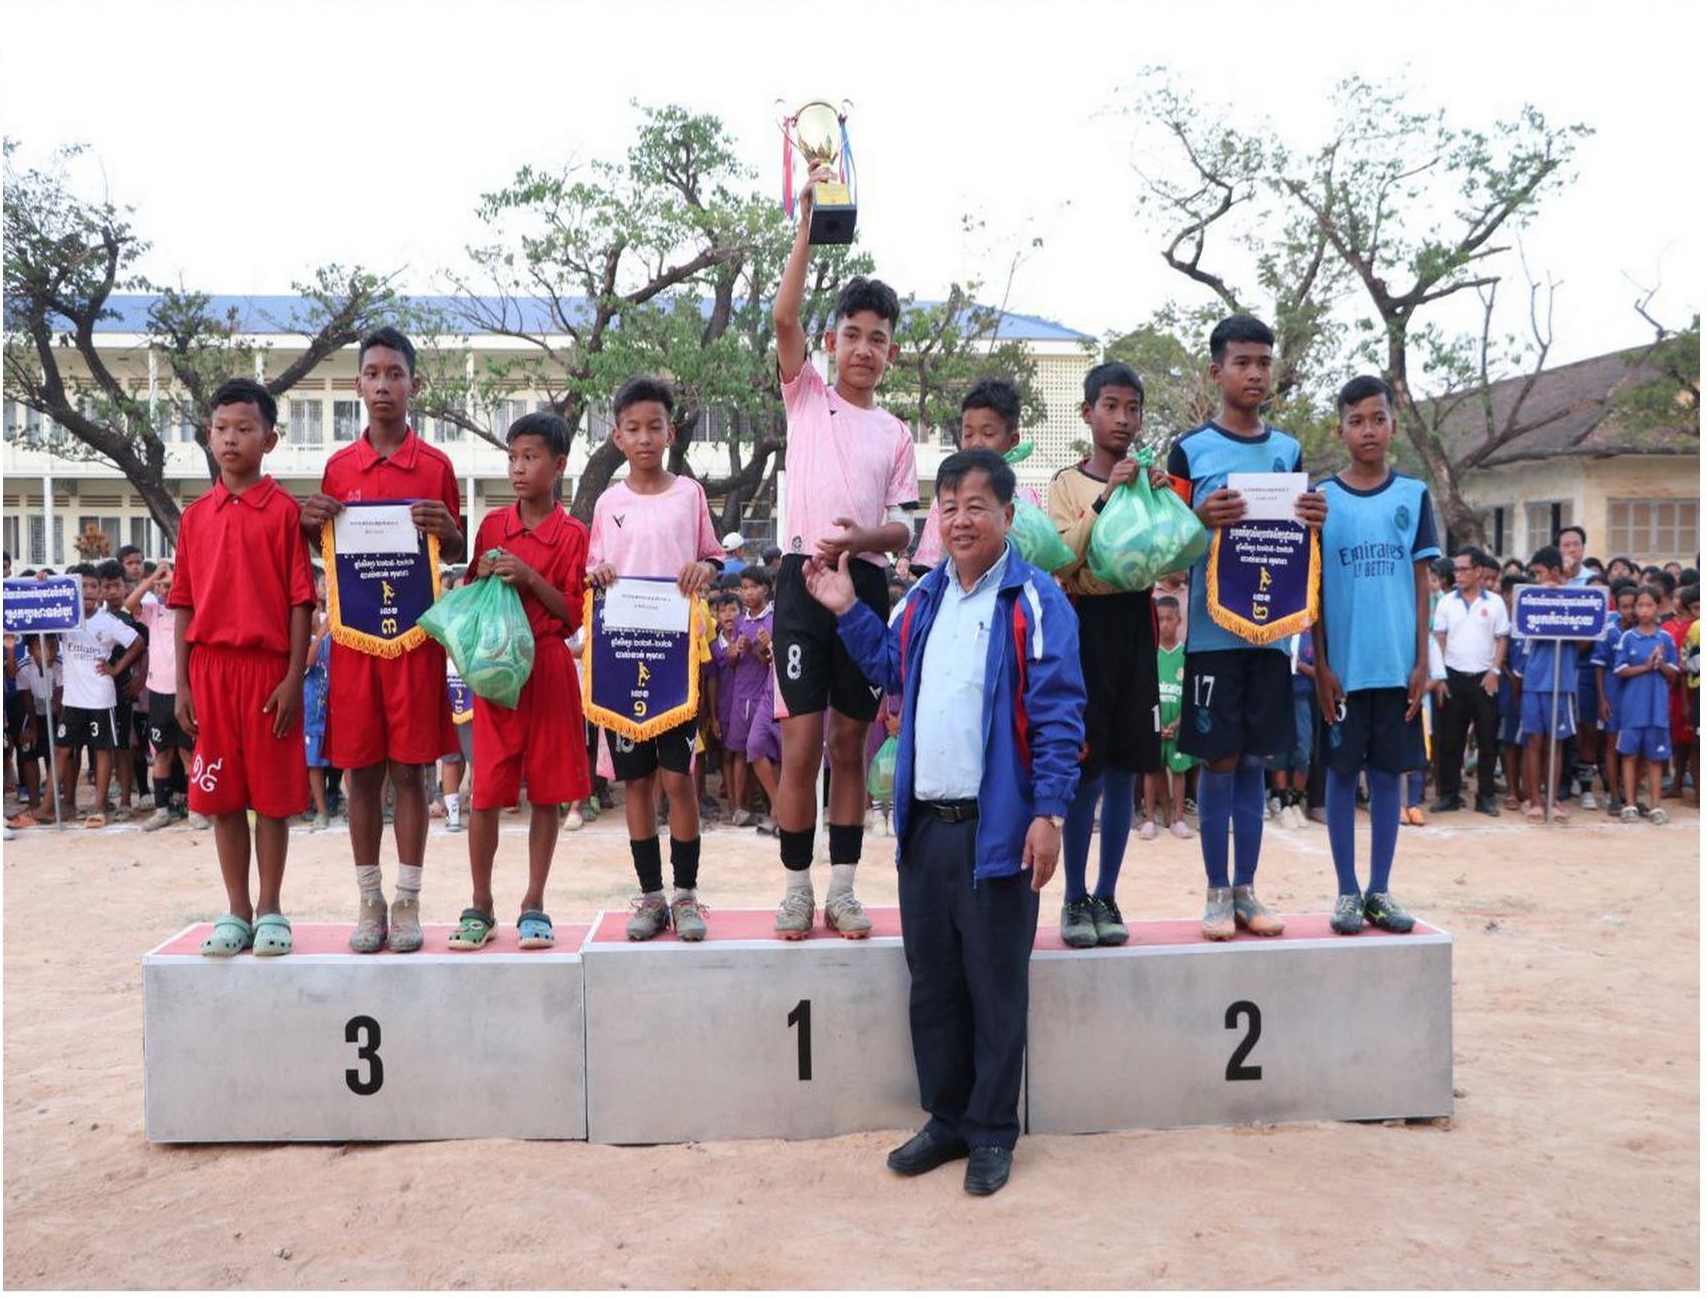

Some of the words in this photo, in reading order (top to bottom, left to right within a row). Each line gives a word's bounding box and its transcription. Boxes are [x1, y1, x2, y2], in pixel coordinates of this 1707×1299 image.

[1339, 544, 1405, 567] Emirates
[1252, 602, 1268, 619] ២
[382, 618, 398, 633] ៣
[786, 644, 802, 679] 8
[1193, 674, 1215, 707] 17
[633, 700, 647, 717] ១
[89, 721, 99, 737] 3
[788, 1000, 811, 1080] 1
[1225, 1001, 1261, 1081] 2
[345, 1016, 383, 1095] 3
